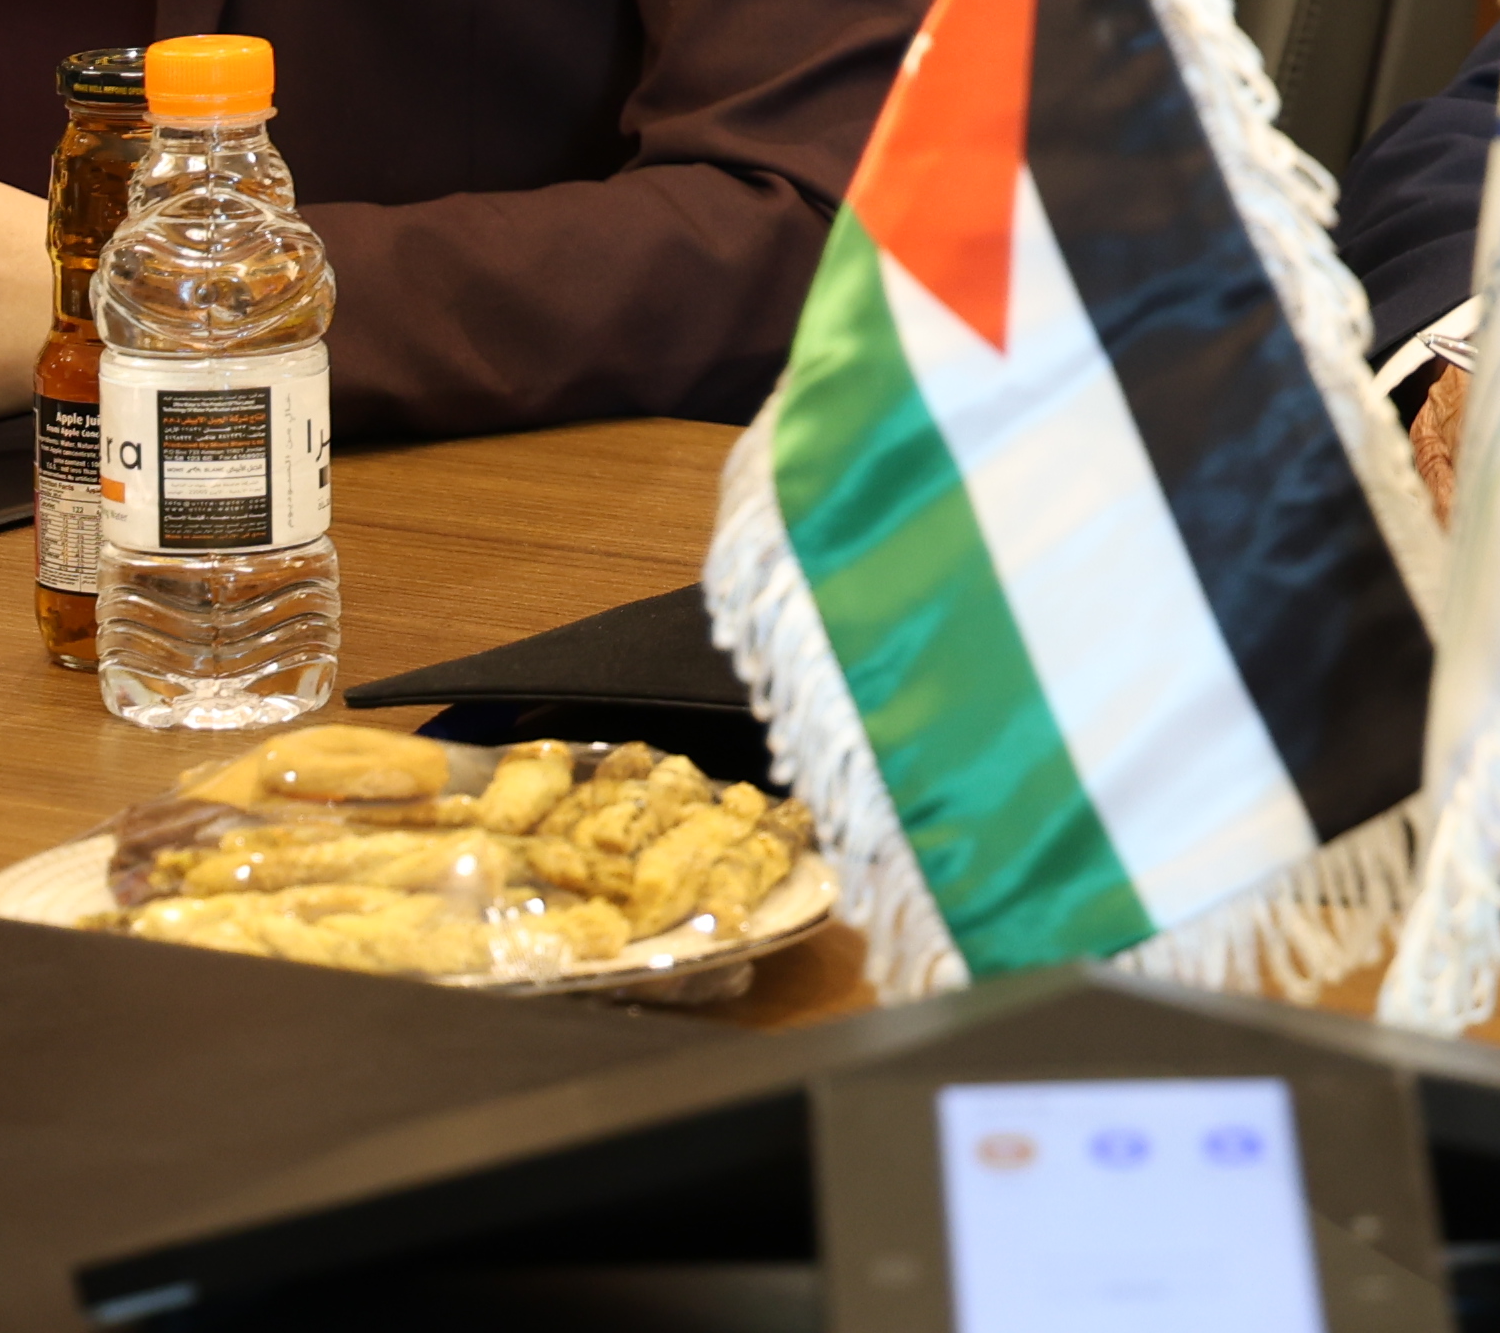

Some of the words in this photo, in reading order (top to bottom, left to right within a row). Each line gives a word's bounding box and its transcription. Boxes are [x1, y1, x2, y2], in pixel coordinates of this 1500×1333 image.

[56, 412, 83, 426] Apple
[85, 414, 100, 428] Jui
[72, 506, 84, 514] 122
